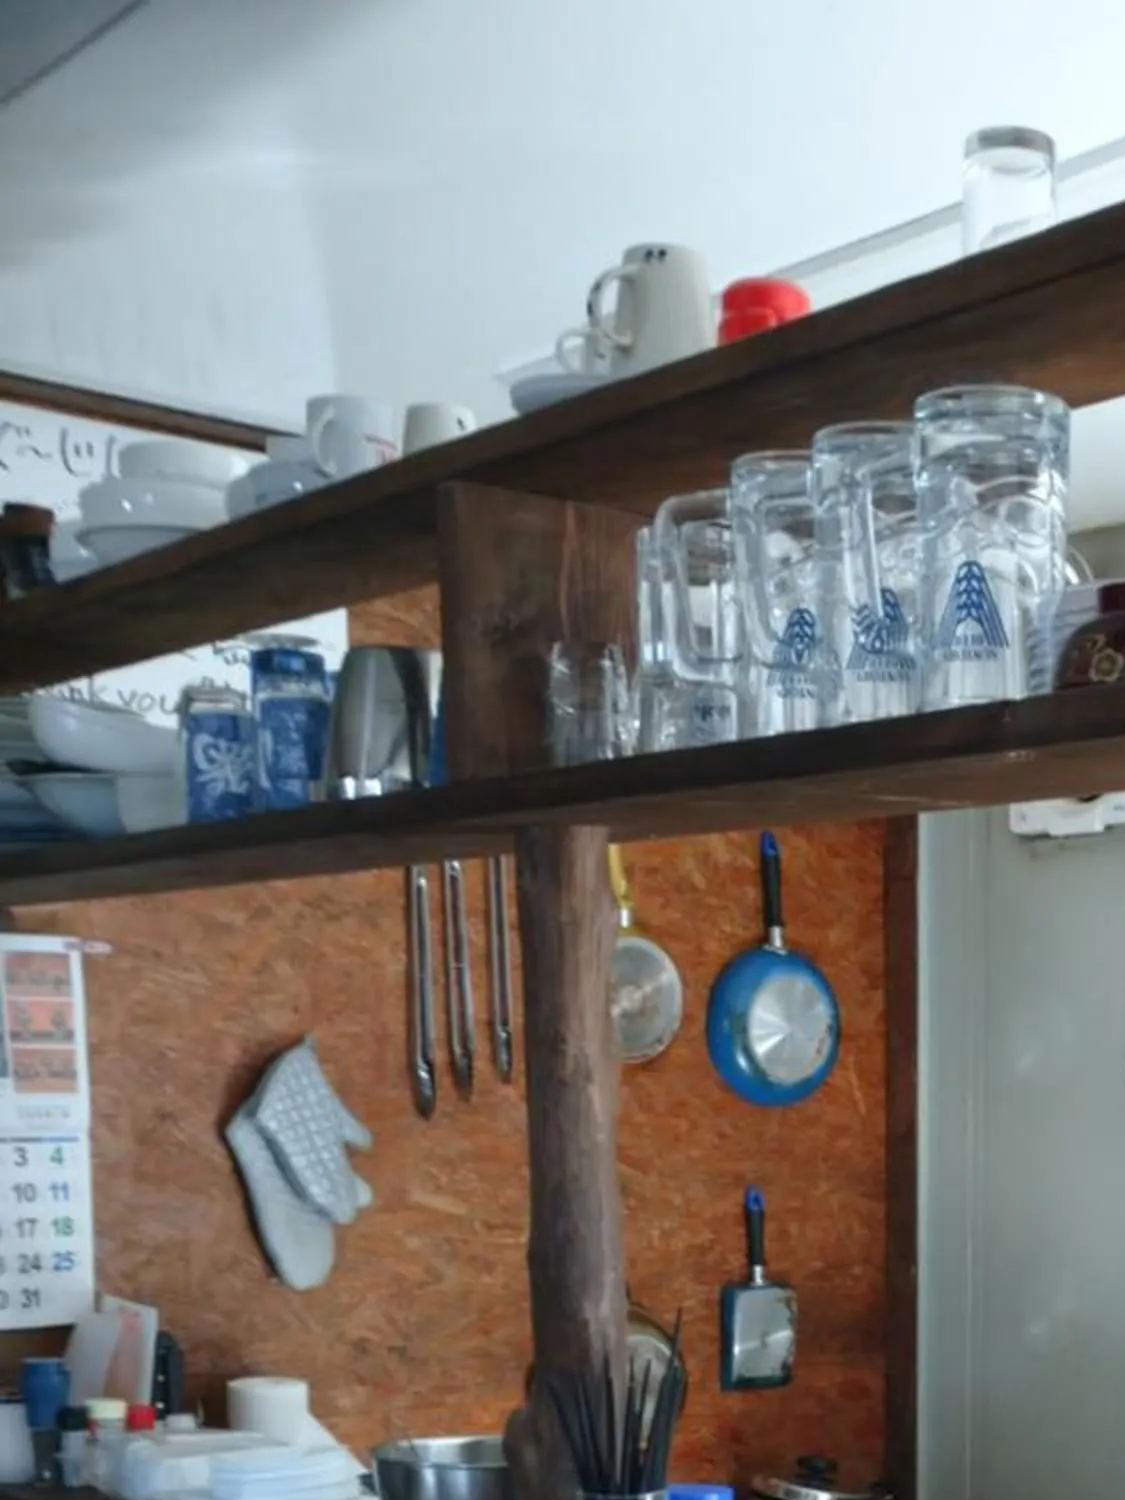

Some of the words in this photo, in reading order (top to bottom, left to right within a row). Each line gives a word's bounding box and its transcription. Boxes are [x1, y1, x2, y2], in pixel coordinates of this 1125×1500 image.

[13, 1146, 28, 1167] 3
[49, 1145, 64, 1166] 4
[12, 1182, 37, 1203] 10
[50, 1180, 70, 1202] 11
[16, 1217, 39, 1238] 17
[52, 1215, 75, 1237] 18
[17, 1253, 42, 1274] 24
[53, 1250, 76, 1272] 25
[21, 1286, 41, 1309] 31
